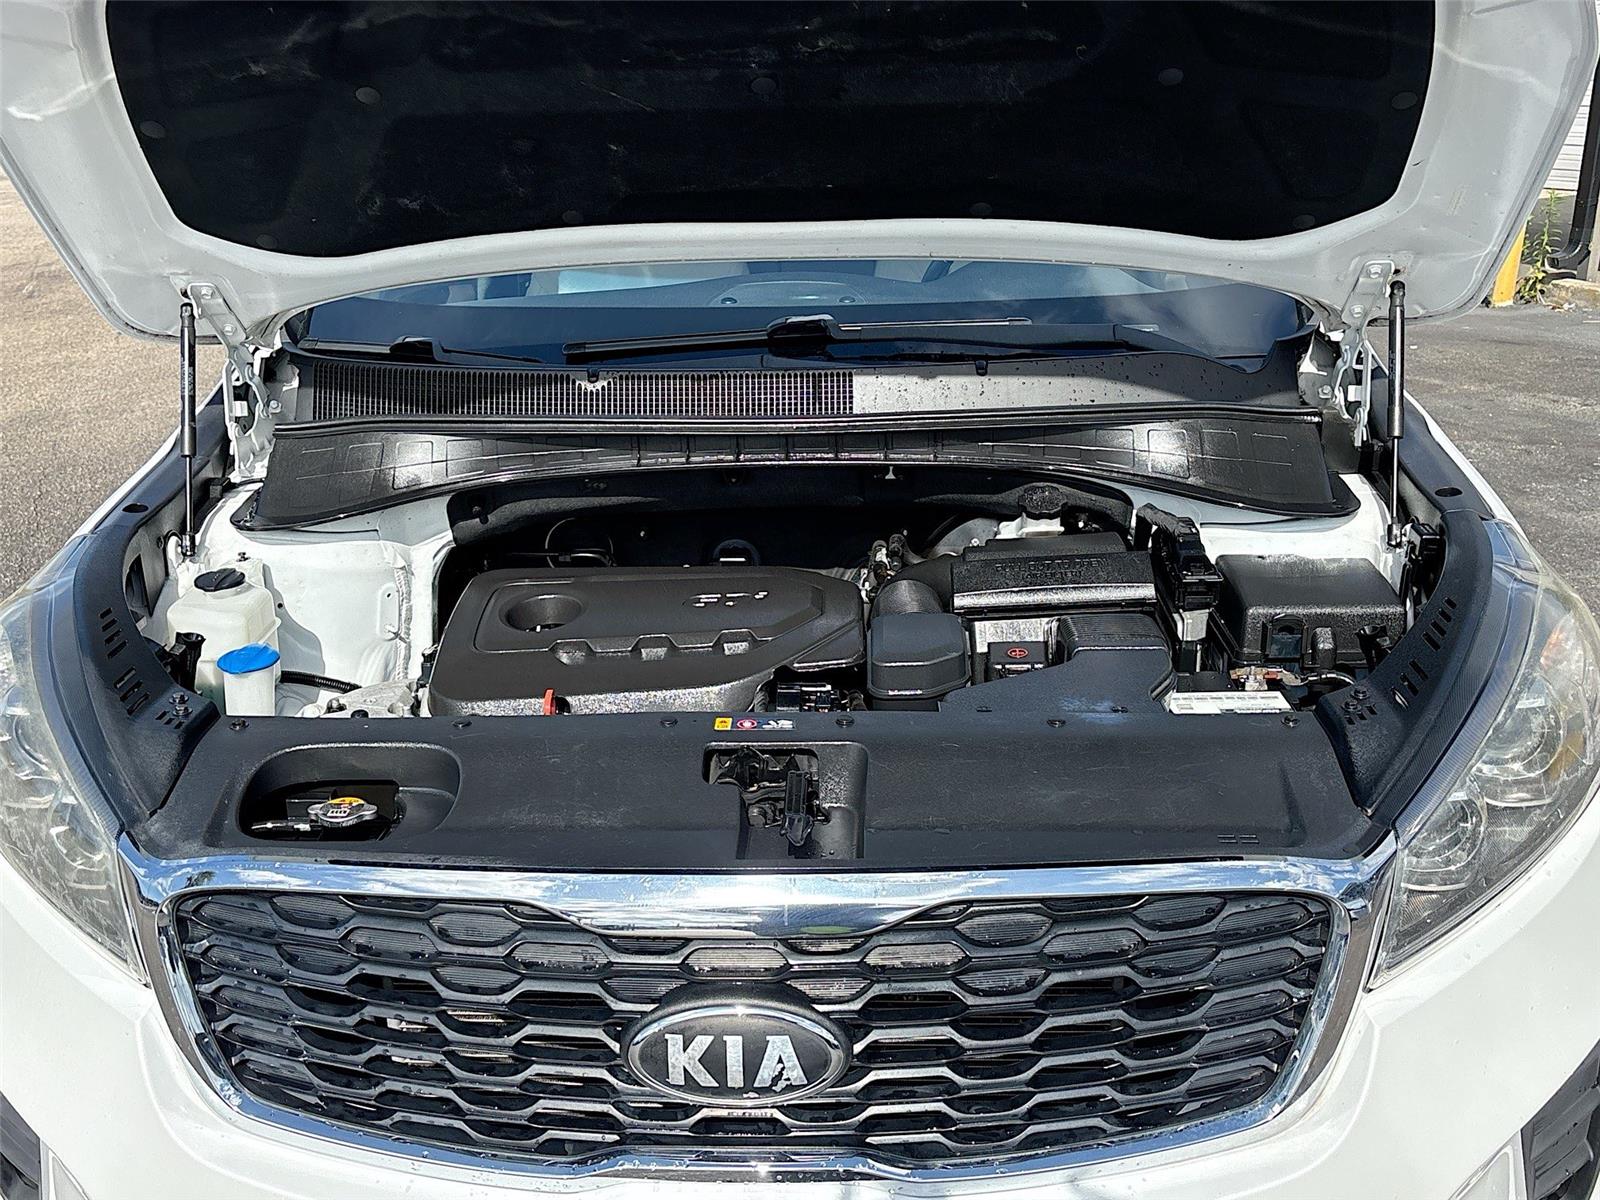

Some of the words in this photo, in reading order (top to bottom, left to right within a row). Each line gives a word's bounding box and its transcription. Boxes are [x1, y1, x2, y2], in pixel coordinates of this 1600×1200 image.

[994, 562, 1026, 572] PULL
[1027, 560, 1052, 571] OUT
[1054, 559, 1070, 570] TO
[1074, 558, 1106, 569] OPEN
[665, 1033, 808, 1090] KIA
